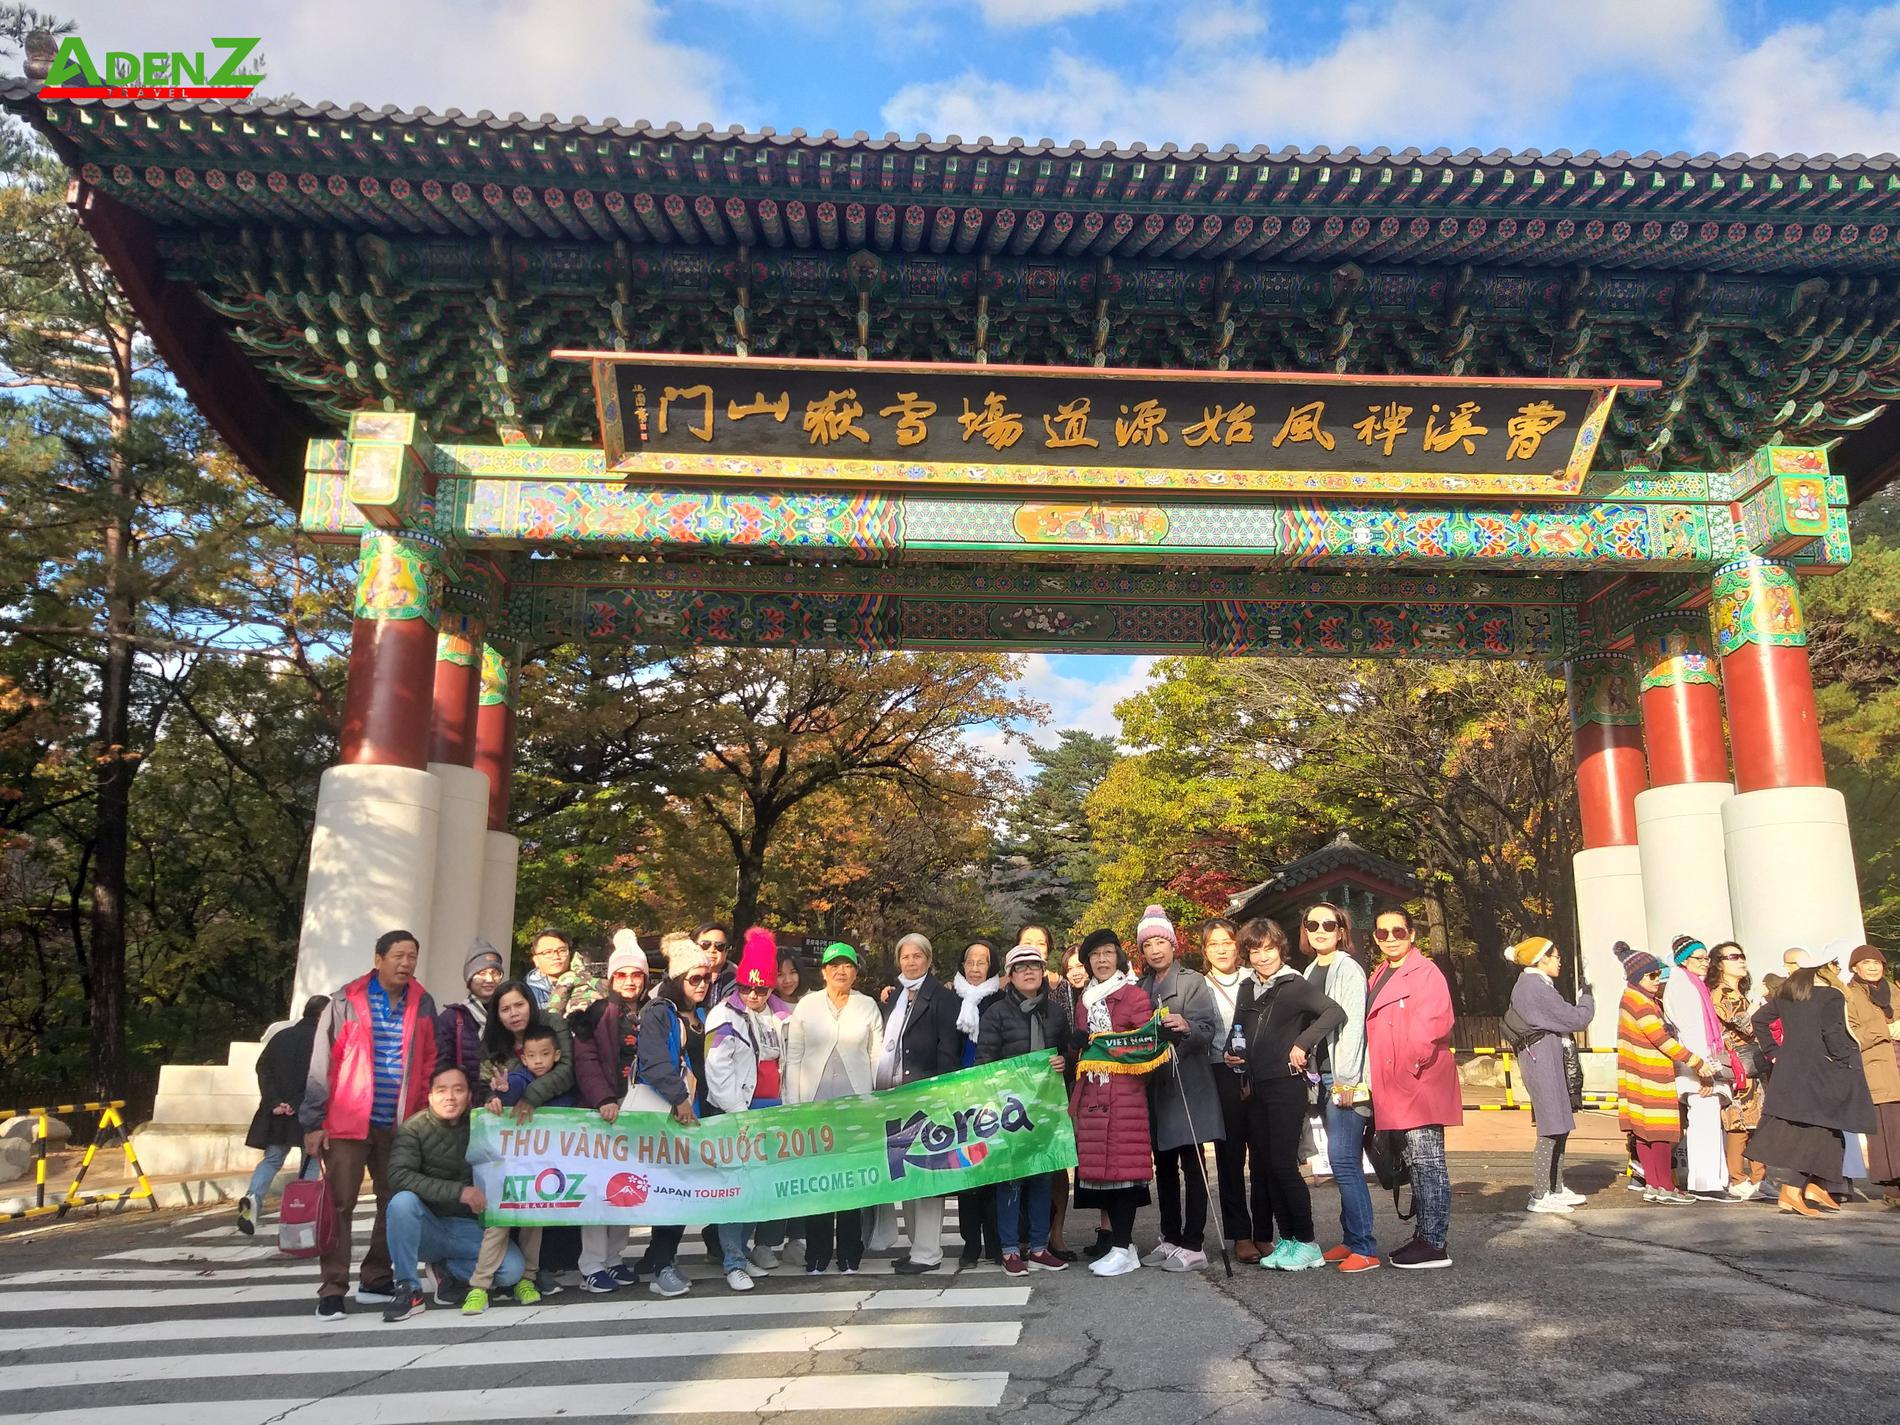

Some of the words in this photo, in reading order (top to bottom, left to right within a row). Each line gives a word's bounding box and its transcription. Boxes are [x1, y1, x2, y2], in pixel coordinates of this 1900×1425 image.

[499, 1129, 551, 1157] THU
[560, 1126, 628, 1162] VÀNG
[638, 1130, 691, 1165] HÀN
[700, 1125, 768, 1168] QUỐC
[776, 1124, 834, 1158] 2019
[885, 1096, 1035, 1181] Korea
[653, 1185, 692, 1198] JAPAN
[694, 1186, 743, 1198] TOURIST
[774, 1170, 854, 1198] WELCOME
[860, 1166, 880, 1185] TO
